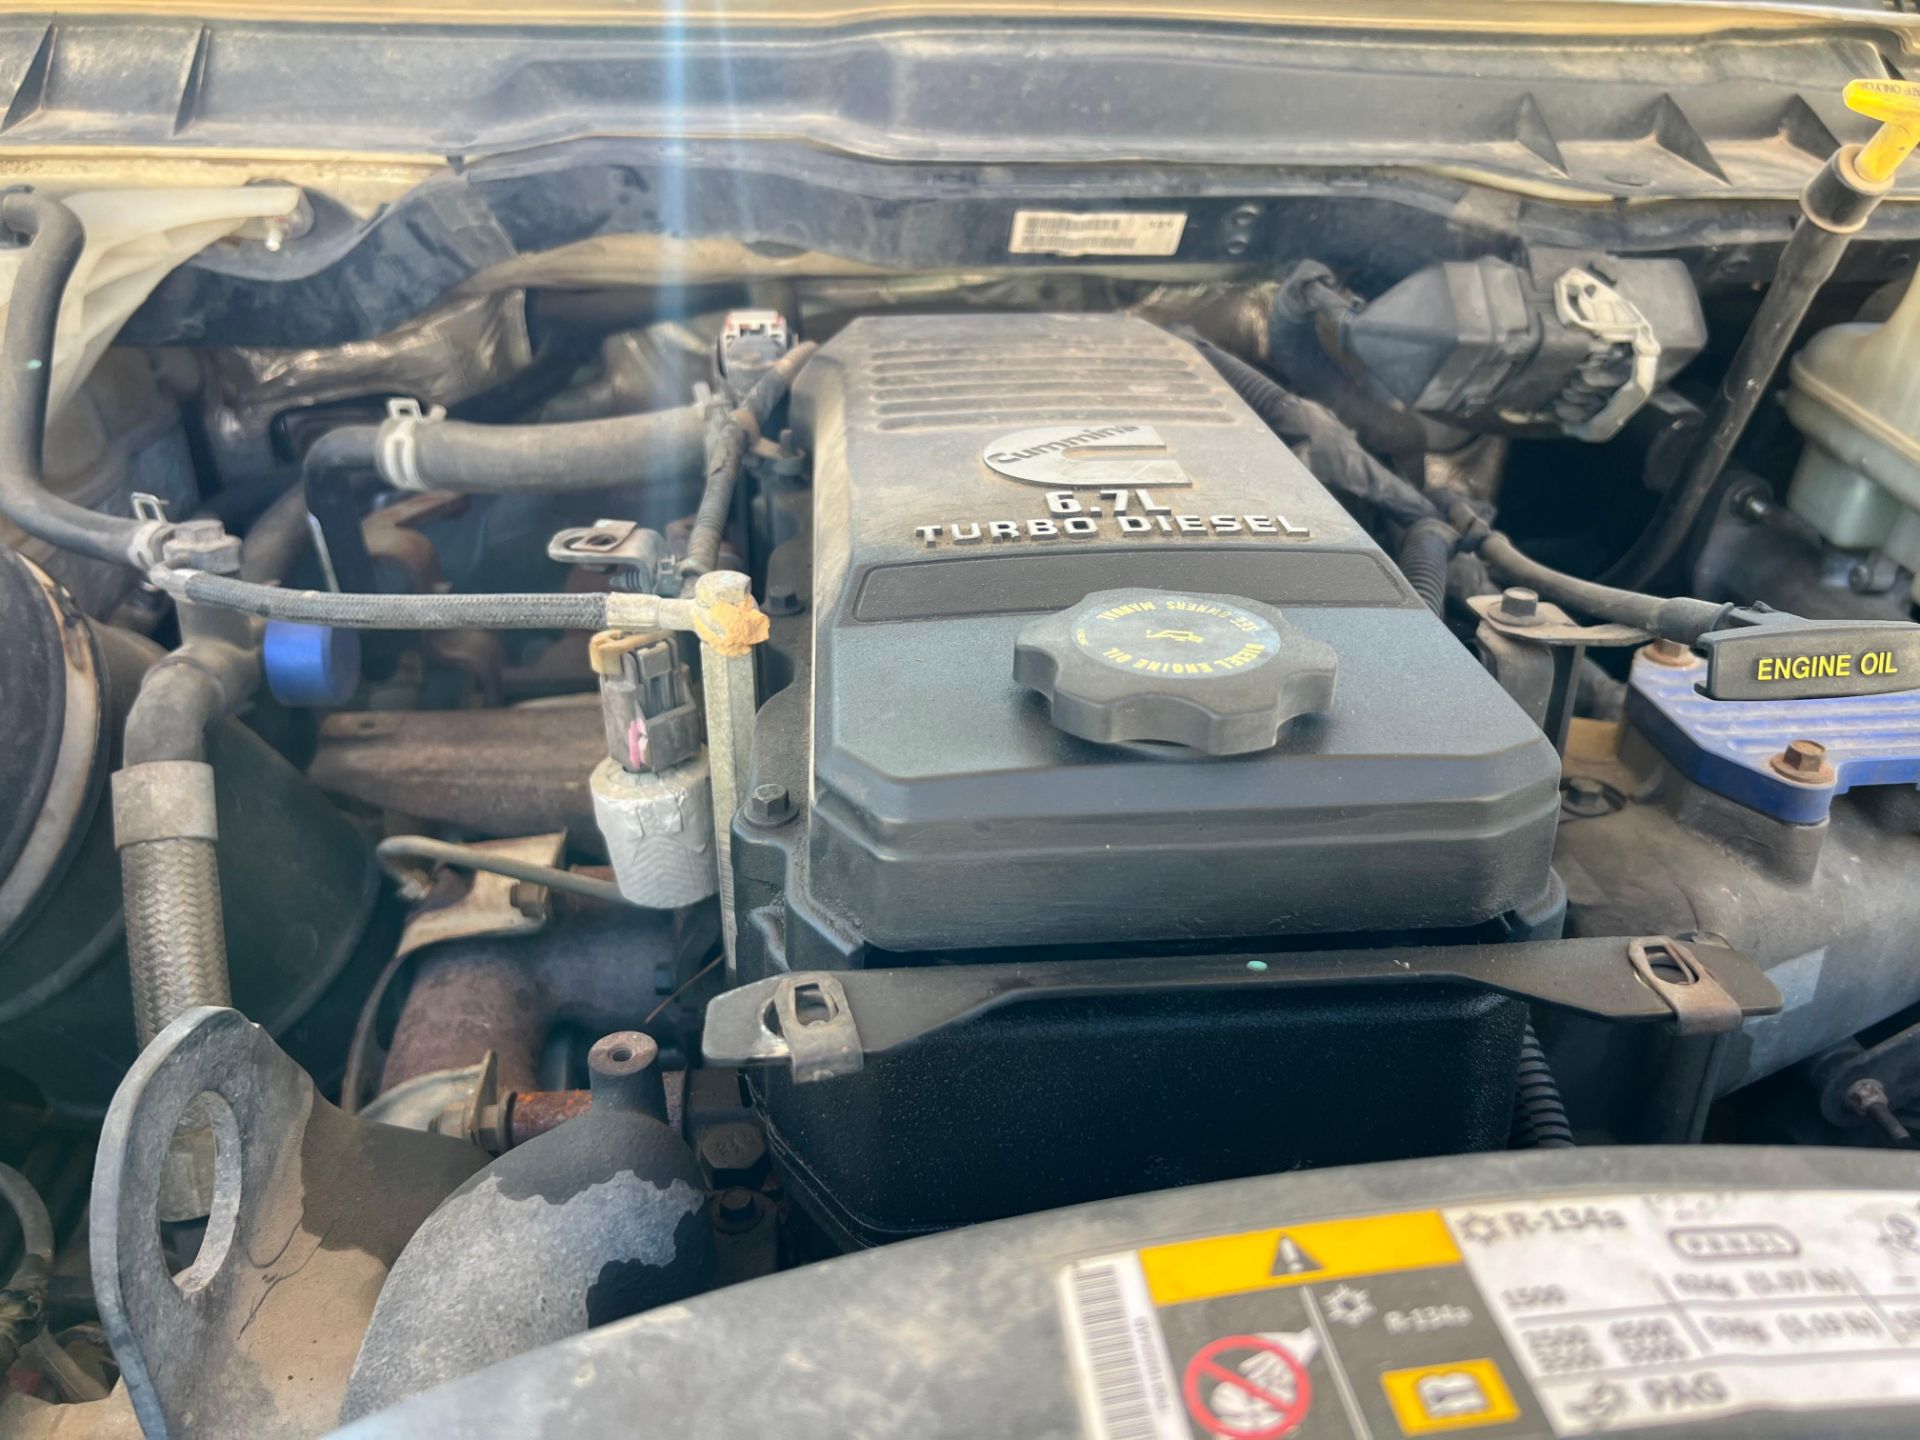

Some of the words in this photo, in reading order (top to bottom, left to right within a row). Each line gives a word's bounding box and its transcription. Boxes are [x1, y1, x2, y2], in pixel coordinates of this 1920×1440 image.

[987, 425, 1140, 464] Cummins
[1045, 488, 1172, 517] 6.7L
[915, 516, 1098, 548] TURBO
[1116, 514, 1311, 538] DIESEL
[1096, 601, 1157, 621] MANUAL
[1103, 647, 1133, 664] OIL
[1132, 658, 1214, 673] ENGINE
[1213, 643, 1265, 669] DIESEL
[1757, 654, 1851, 681] ENGINE
[1860, 651, 1898, 676] OIL
[1505, 1207, 1627, 1237] R-134a
